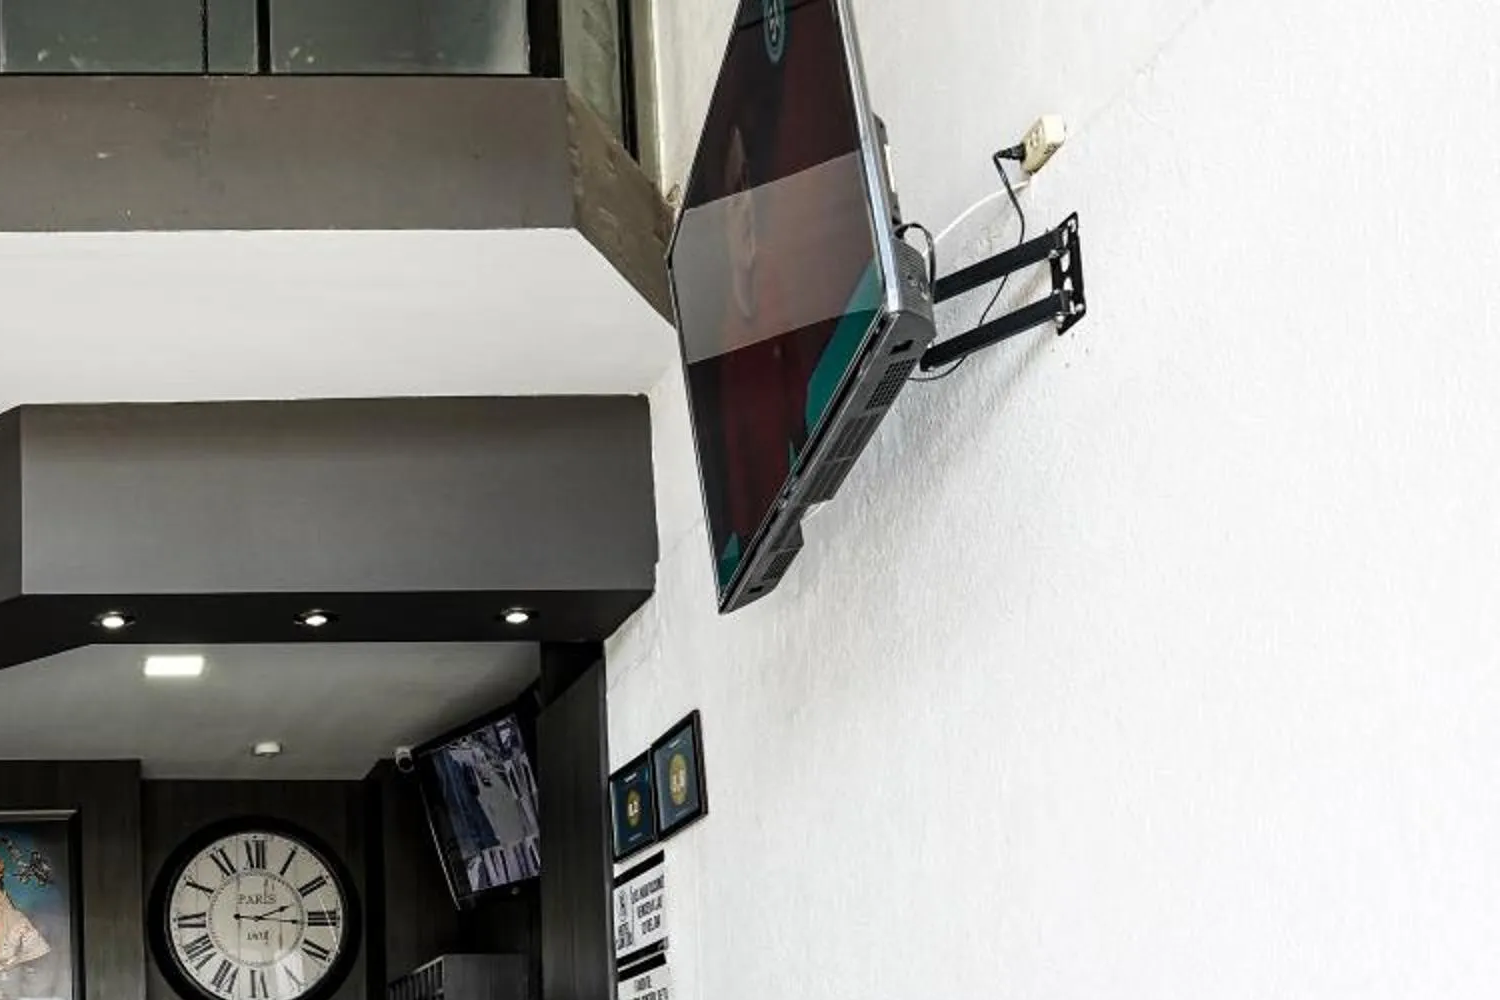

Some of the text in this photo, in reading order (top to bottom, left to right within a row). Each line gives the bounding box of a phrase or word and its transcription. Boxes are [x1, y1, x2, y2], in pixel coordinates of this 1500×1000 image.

[244, 840, 266, 869] XII
[279, 847, 298, 875] I
[298, 875, 328, 897] II
[237, 893, 277, 905] PARIS
[307, 909, 339, 927] III
